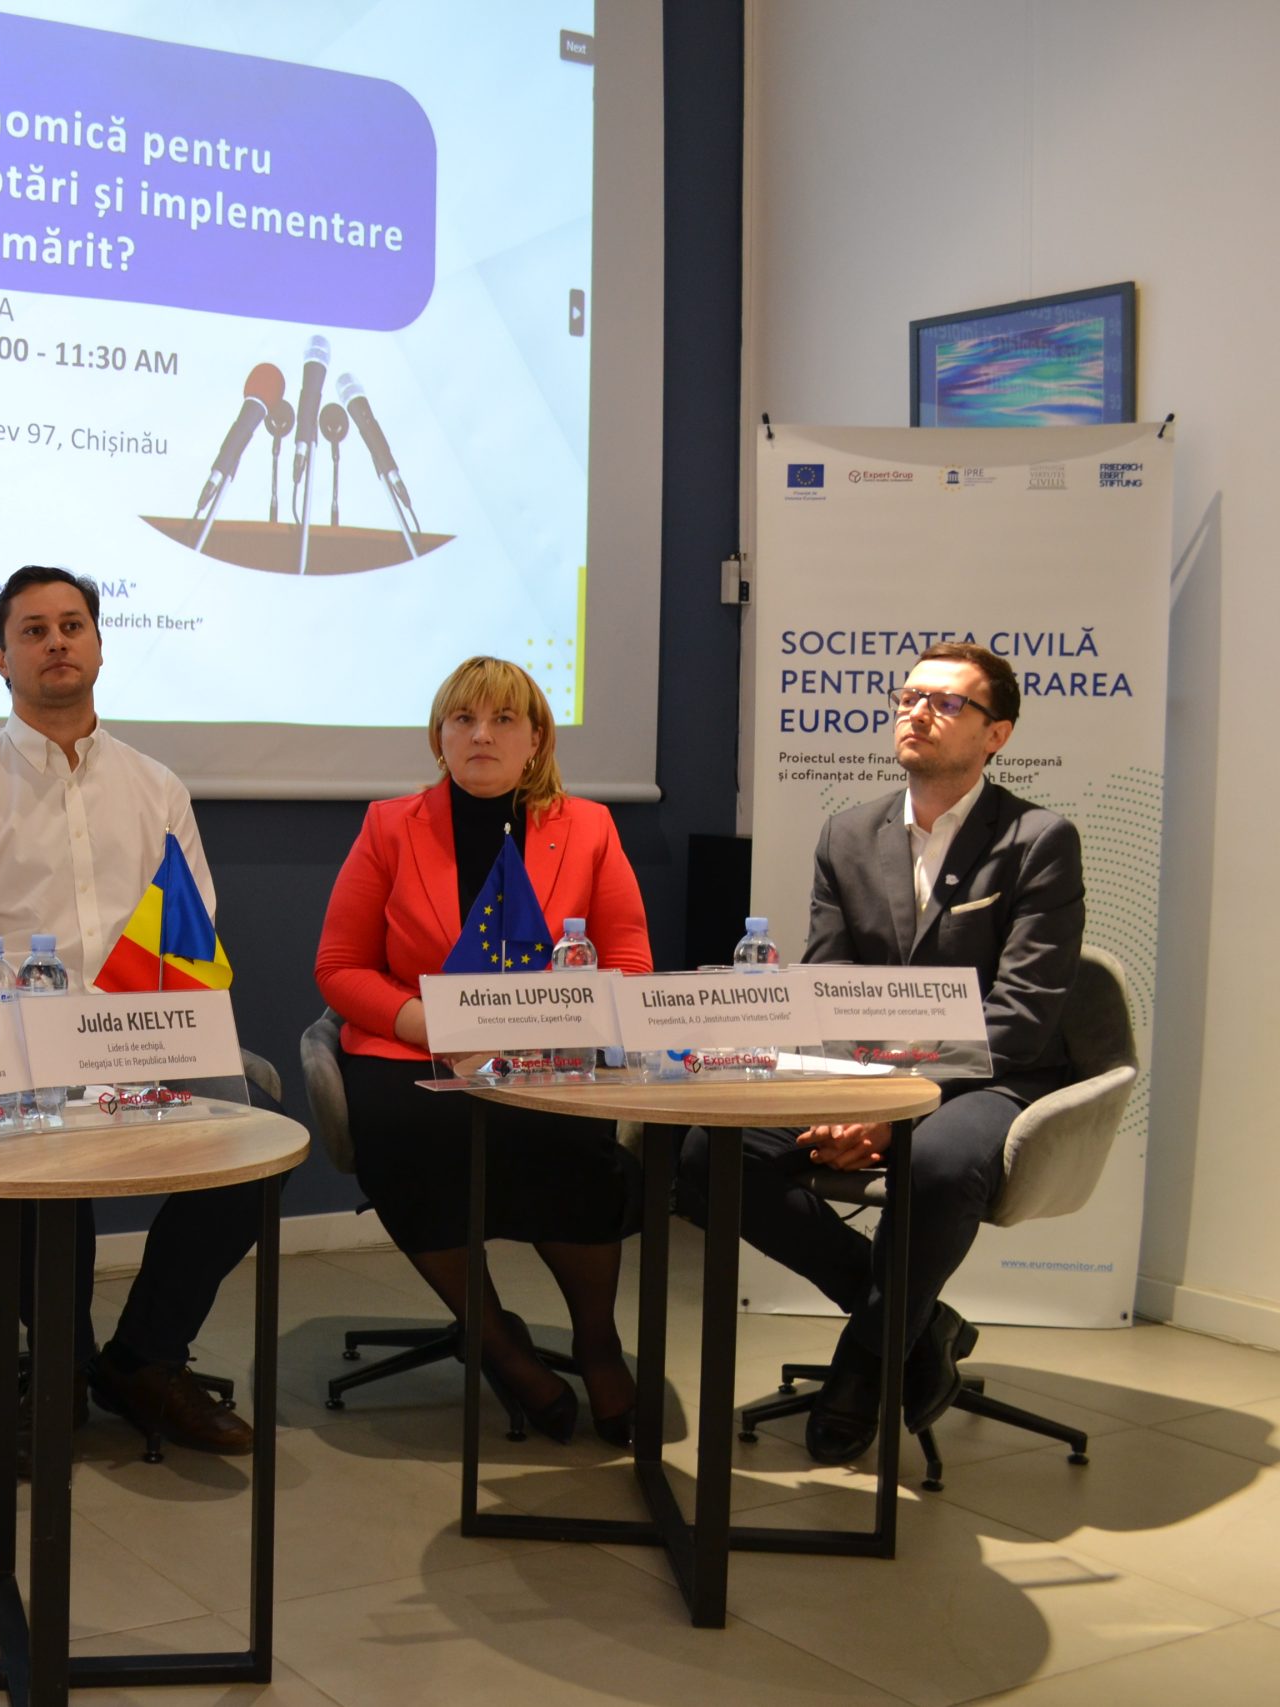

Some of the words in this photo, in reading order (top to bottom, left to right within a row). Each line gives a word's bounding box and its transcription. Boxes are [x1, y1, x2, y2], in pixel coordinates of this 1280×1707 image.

[143, 131, 271, 175] pentru
[94, 177, 124, 218] și
[140, 181, 403, 251] implementare
[55, 343, 127, 371] 11:30
[134, 348, 178, 375] AM
[27, 422, 63, 452] 97,
[71, 428, 168, 457] Chișinău
[963, 468, 984, 477] IPRE
[1099, 463, 1143, 472] FRIEDRICH
[1099, 471, 1125, 480] EBERT
[1099, 479, 1143, 488] STIFTUNG
[990, 627, 1099, 657] CIVILĂ
[779, 752, 835, 764] Proiectul
[839, 755, 865, 764] este
[996, 754, 1063, 768] Europeană
[778, 769, 788, 782] și
[791, 769, 855, 783] cofinanțat
[857, 770, 873, 781] de
[813, 981, 883, 998] Stanislav
[459, 989, 511, 1007] Adrian
[516, 987, 595, 1009] LUPUȘOR
[642, 990, 695, 1008] Liliana
[698, 987, 790, 1006] PALIHOVICI
[741, 1013, 768, 1023] Virtutes
[834, 1007, 860, 1016] Director
[862, 1007, 886, 1017] adjunct
[888, 1009, 896, 1017] pe
[77, 1012, 123, 1033] Julda
[127, 1009, 197, 1031] KIELYTE
[478, 1015, 506, 1025] Director
[507, 1015, 539, 1025] executiv,
[540, 1014, 582, 1025] Expert-Grup
[131, 1042, 140, 1052] de
[113, 1058, 123, 1067] UE
[133, 1055, 167, 1067] Republica
[168, 1054, 197, 1064] Moldova
[1000, 1259, 1113, 1273] www.euromonitor.md
